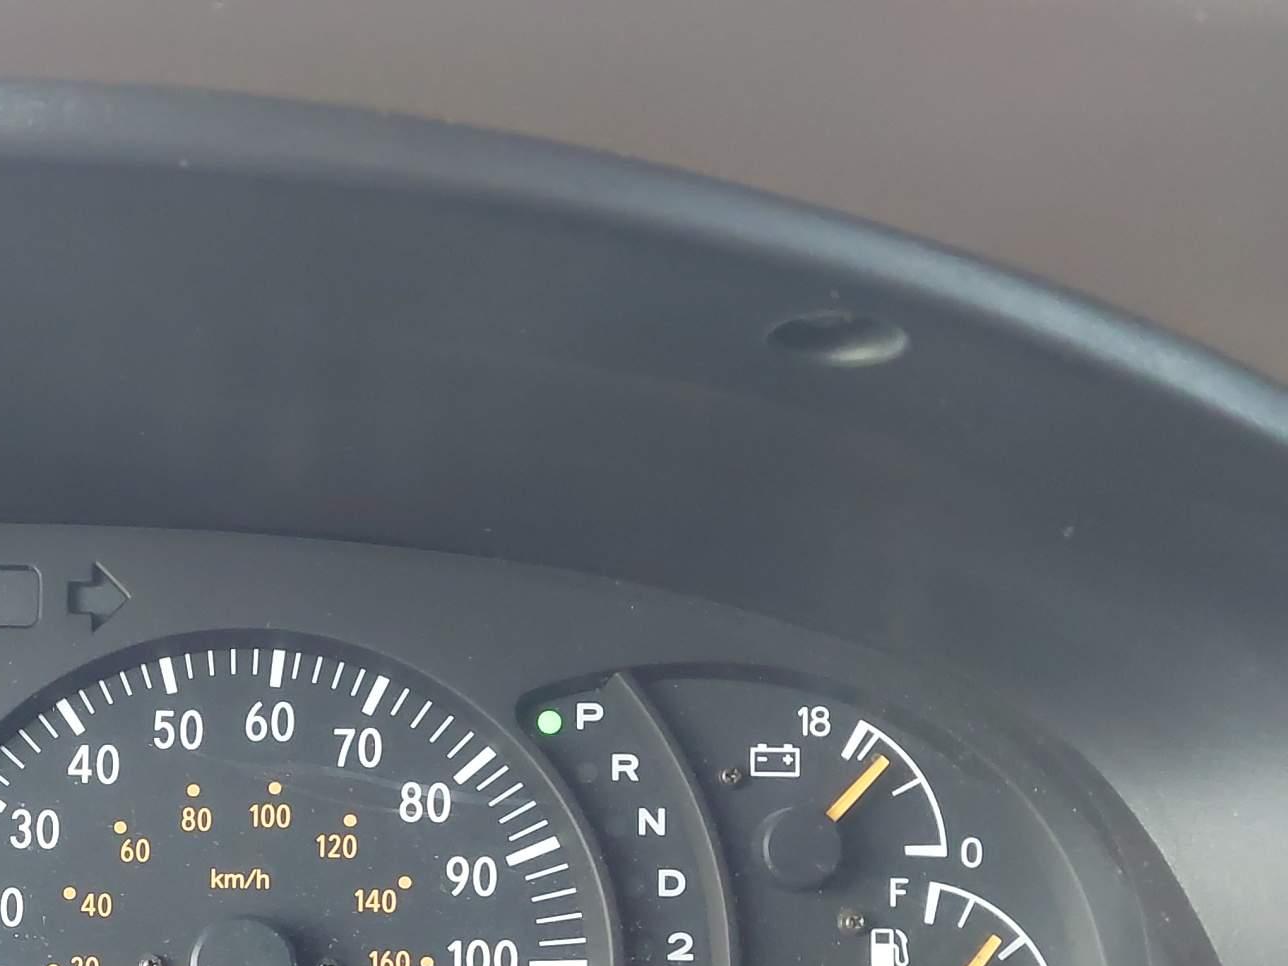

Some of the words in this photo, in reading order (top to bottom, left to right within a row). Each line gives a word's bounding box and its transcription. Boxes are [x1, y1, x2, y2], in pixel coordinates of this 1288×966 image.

[154, 710, 203, 749] 50
[246, 702, 294, 741] 60
[577, 703, 603, 729] P
[798, 706, 830, 736] 18
[334, 728, 381, 767] 70
[68, 745, 119, 784] 40
[612, 754, 638, 781] R
[250, 804, 290, 827] 100
[400, 782, 450, 822] 80
[10, 809, 59, 849] 30
[182, 807, 211, 831] 80
[639, 808, 665, 835] N
[121, 839, 149, 862] 60
[317, 835, 357, 858] 120
[961, 837, 982, 868] 0
[211, 869, 269, 889] km/h
[447, 856, 497, 896] 90
[659, 870, 685, 896] D
[81, 894, 111, 917] 40
[355, 890, 396, 913] 140
[890, 878, 909, 907] F
[668, 933, 693, 960] 2
